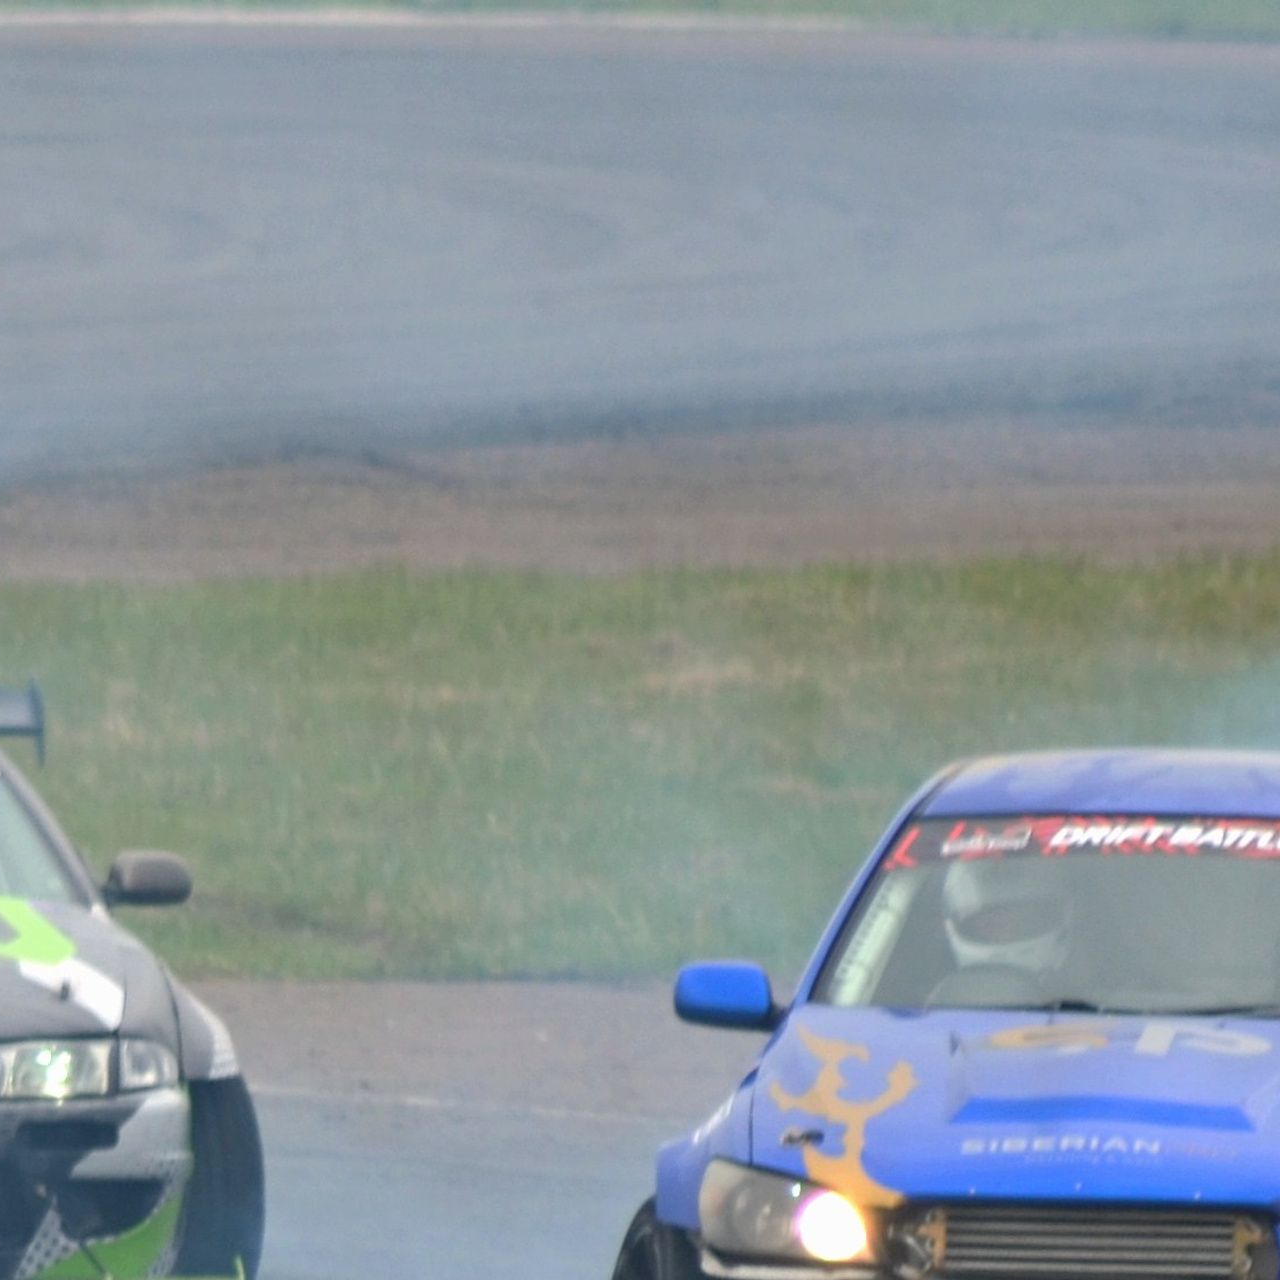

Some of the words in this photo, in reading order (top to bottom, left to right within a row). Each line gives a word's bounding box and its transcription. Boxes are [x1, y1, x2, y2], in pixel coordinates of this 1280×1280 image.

[1049, 825, 1170, 848] DRIFT
[1168, 826, 1280, 850] BATTL
[960, 1134, 1161, 1156] SIBERIAN
